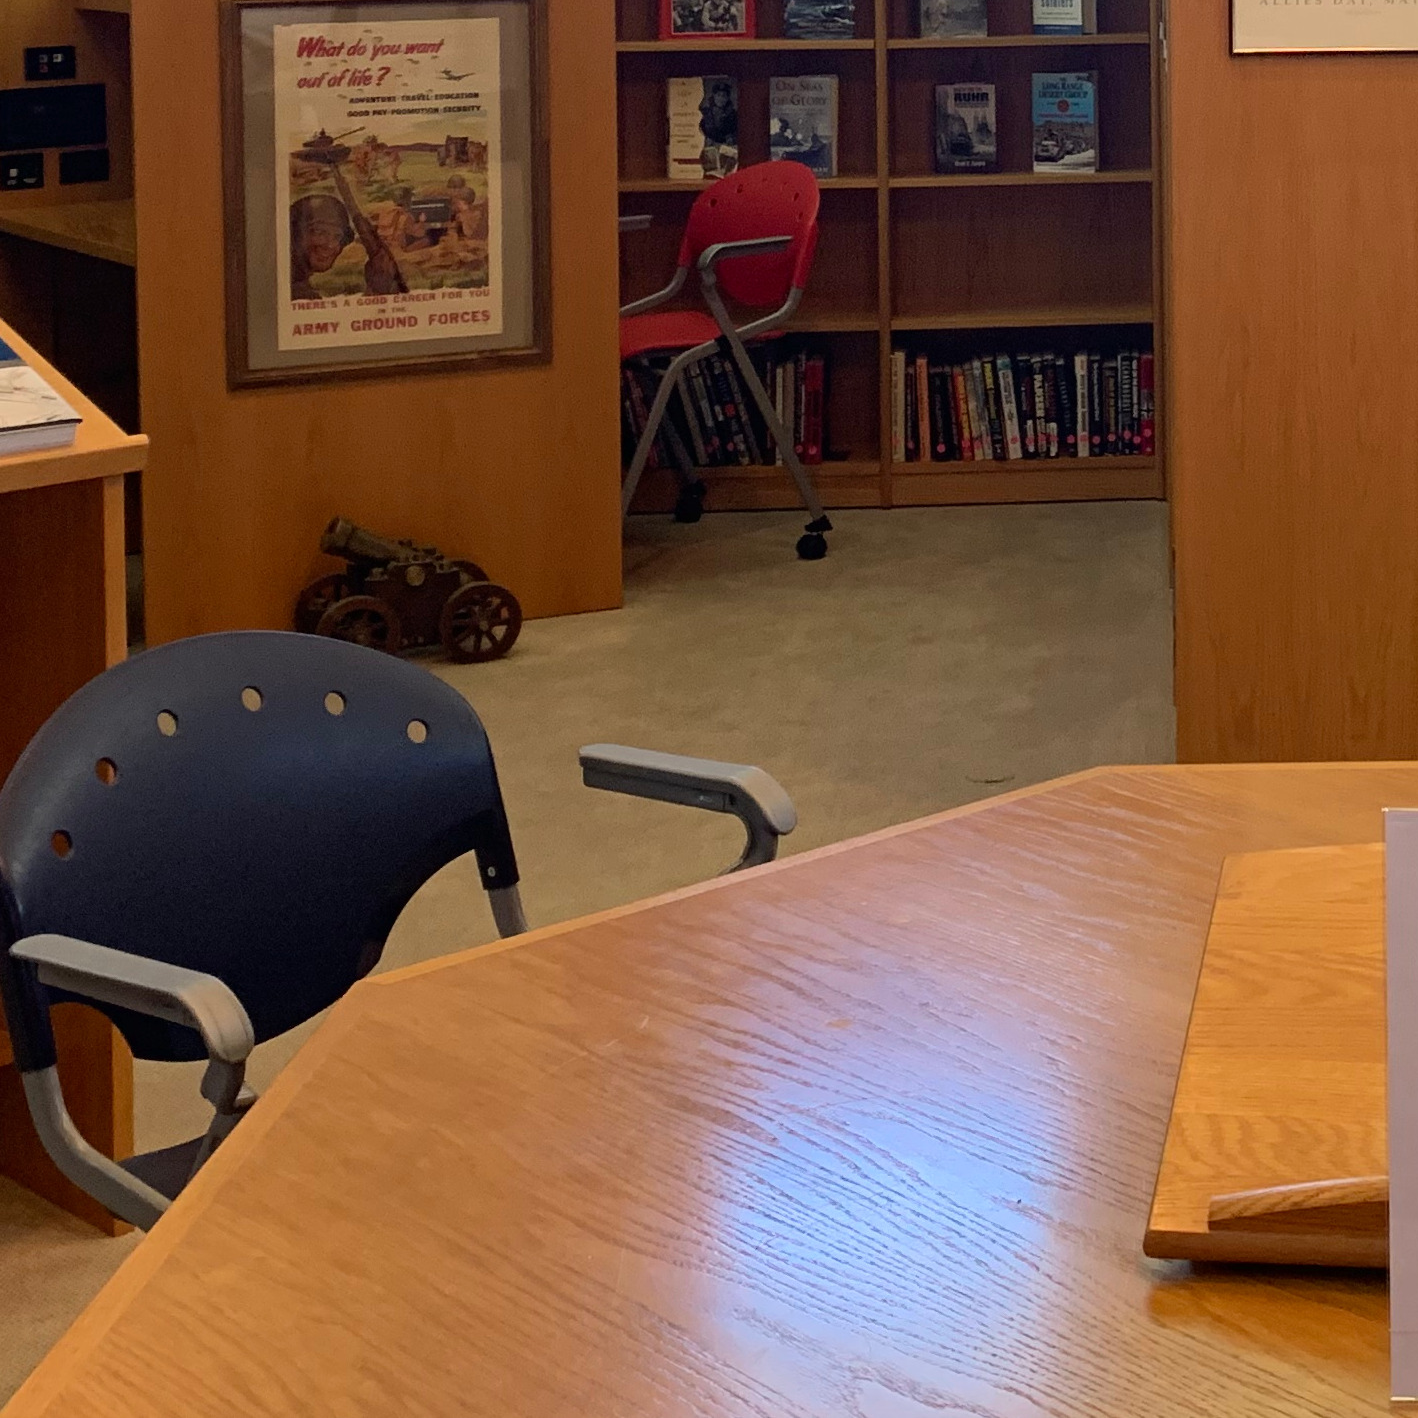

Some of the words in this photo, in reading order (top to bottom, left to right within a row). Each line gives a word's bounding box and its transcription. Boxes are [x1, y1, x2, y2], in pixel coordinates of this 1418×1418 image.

[297, 35, 345, 58] What
[347, 38, 367, 57] do
[370, 43, 401, 61] you
[405, 38, 445, 54] want
[297, 72, 329, 89] out
[328, 68, 349, 88] of
[790, 94, 827, 106] GLORY
[954, 91, 990, 103] RUHR
[347, 109, 370, 117] GOOD
[343, 299, 350, 307] A
[356, 296, 388, 307] GOOD
[393, 294, 436, 304] CAREER
[441, 291, 463, 300] FOR
[469, 289, 491, 298] YOU
[292, 322, 340, 336] ARMY
[351, 315, 418, 332] GROUND
[428, 309, 491, 327] FORCES
